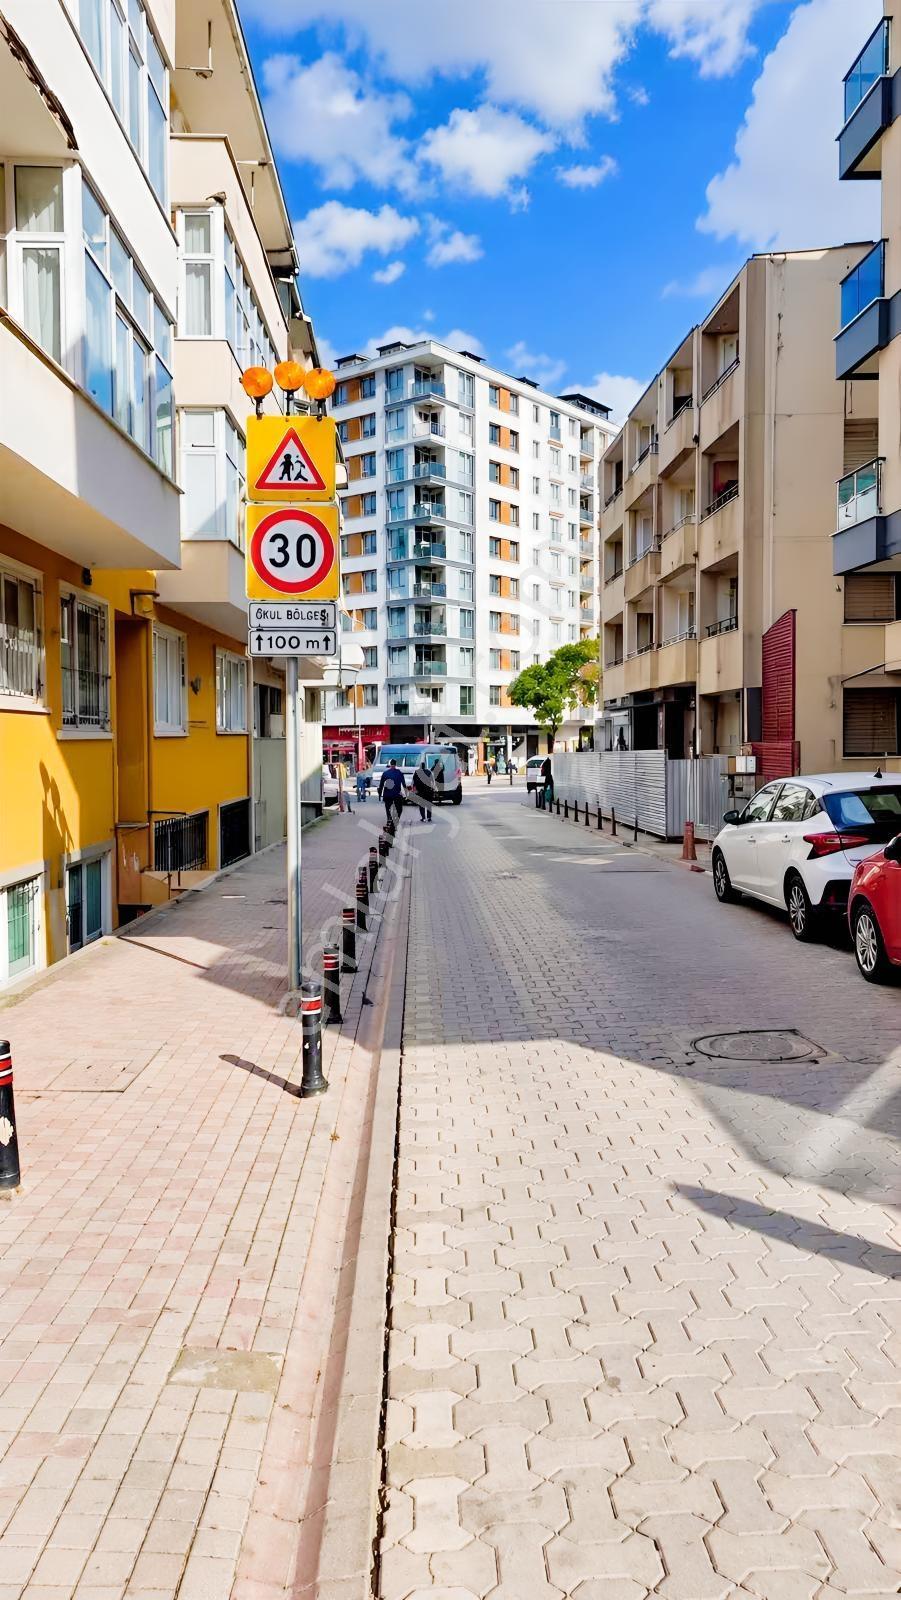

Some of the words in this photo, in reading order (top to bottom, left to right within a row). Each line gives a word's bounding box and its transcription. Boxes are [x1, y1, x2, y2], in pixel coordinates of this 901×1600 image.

[269, 533, 317, 568] 30
[267, 636, 300, 649] 100
[306, 640, 319, 648] m
